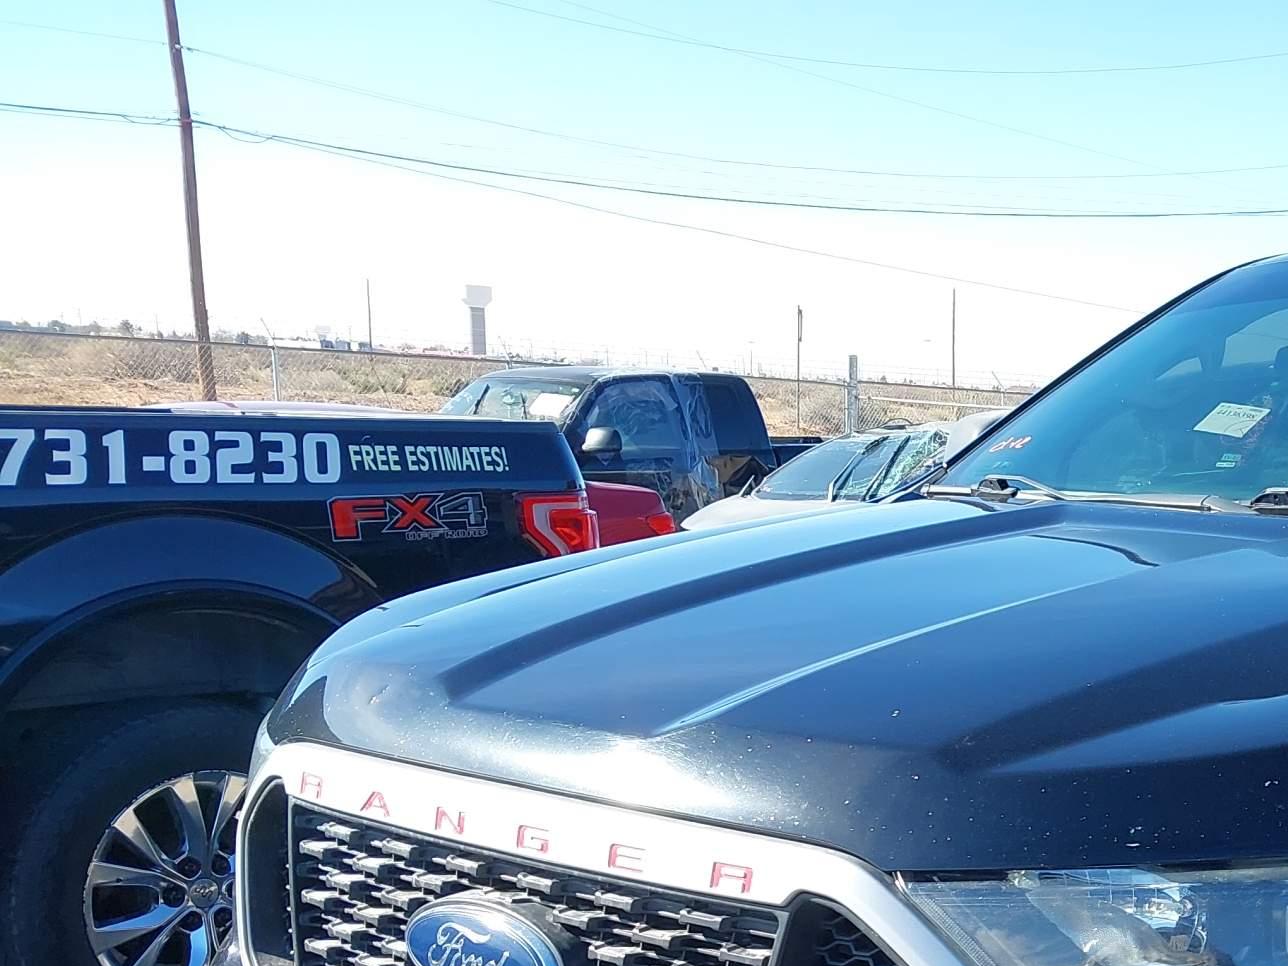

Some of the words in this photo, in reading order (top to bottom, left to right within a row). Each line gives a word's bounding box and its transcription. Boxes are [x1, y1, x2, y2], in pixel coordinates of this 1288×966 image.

[0, 428, 342, 486] 731-8230
[347, 444, 402, 472] FREE
[403, 445, 510, 473] ESTIMATES!
[327, 491, 488, 543] FX4
[300, 771, 754, 895] RANGER
